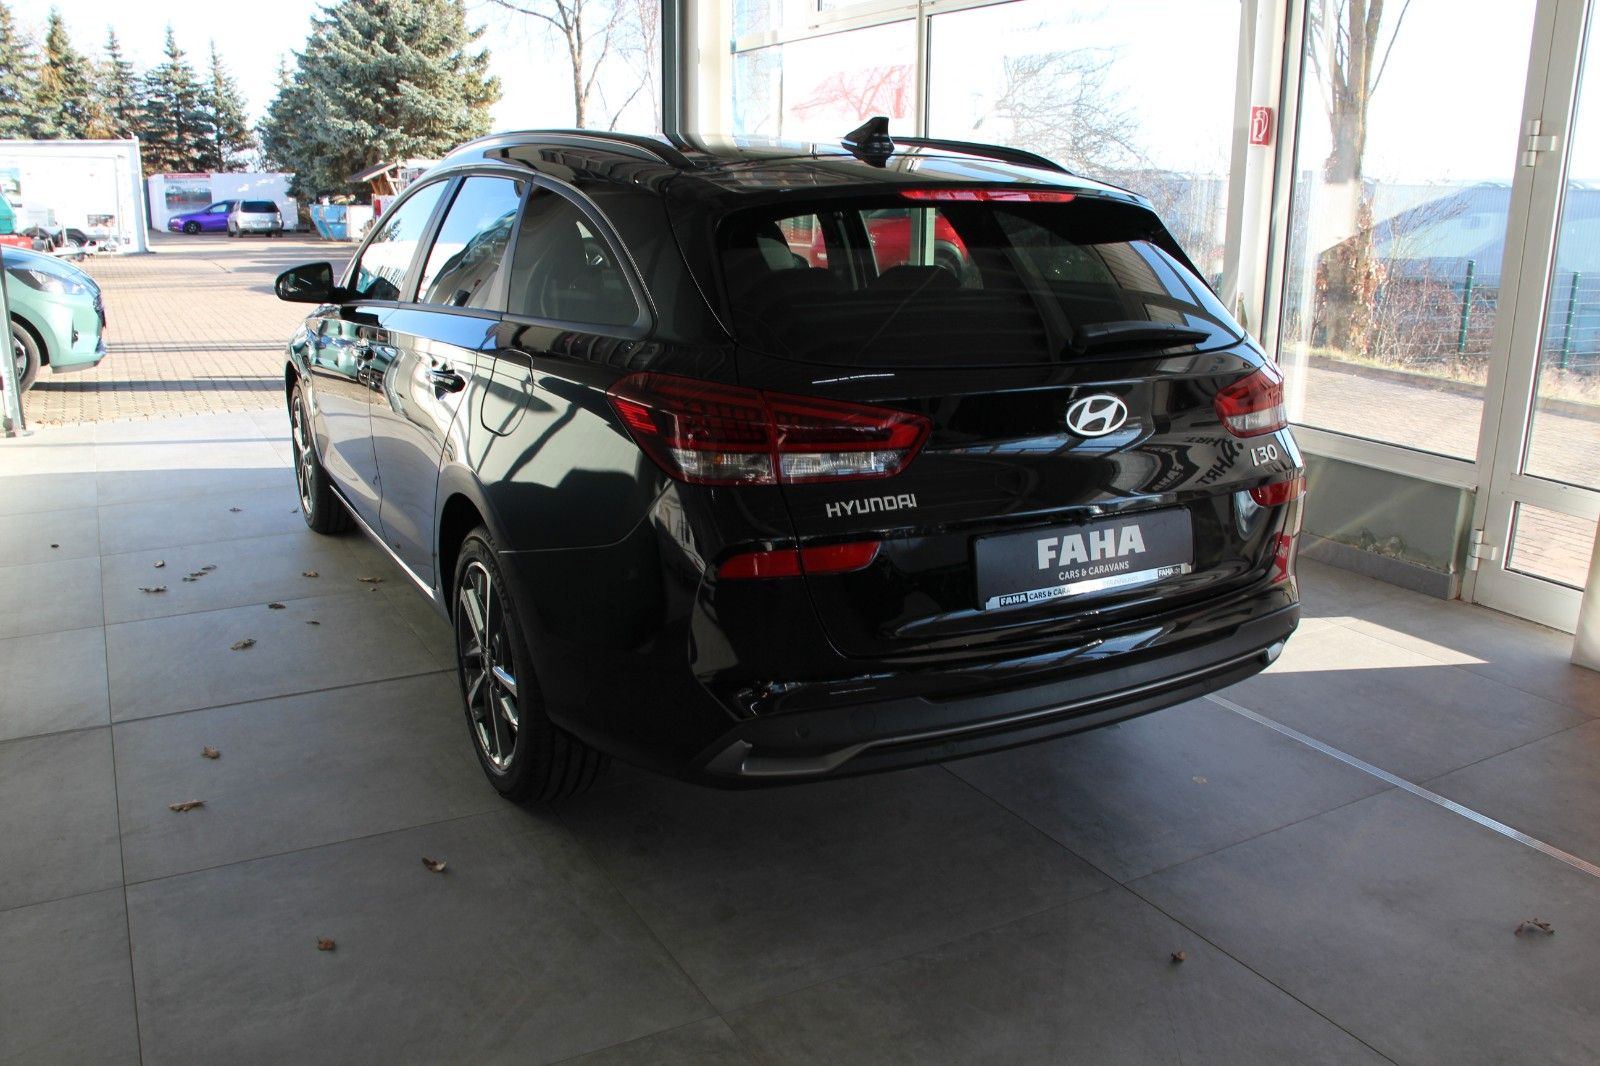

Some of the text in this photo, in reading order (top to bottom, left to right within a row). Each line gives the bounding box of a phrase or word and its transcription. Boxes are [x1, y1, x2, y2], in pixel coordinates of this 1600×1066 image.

[825, 493, 918, 518] HYUNDAI
[1037, 524, 1146, 570] FAHA
[1058, 560, 1129, 581] CARS & CARAVANS
[1000, 593, 1027, 605] FAHA
[1029, 592, 1047, 600] CARS
